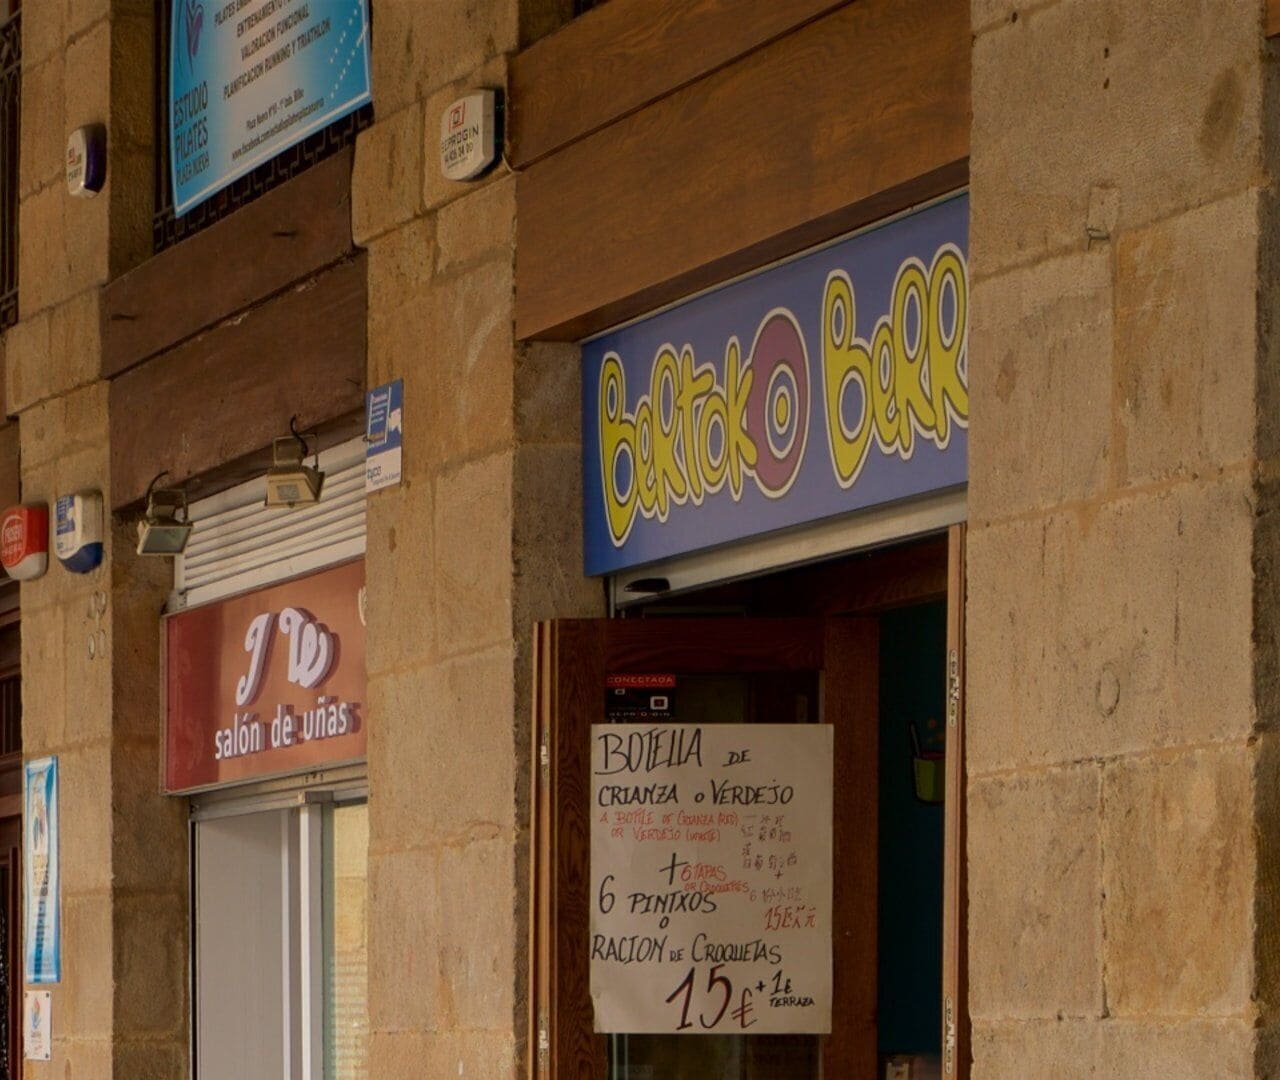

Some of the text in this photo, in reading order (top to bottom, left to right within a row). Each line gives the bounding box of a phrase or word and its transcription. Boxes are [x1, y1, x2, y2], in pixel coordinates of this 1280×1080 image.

[174, 80, 208, 130] ESTUDIO
[821, 241, 969, 489] BeRR
[215, 697, 348, 761] salón de uñas
[594, 727, 752, 775] BOTELLA DE
[598, 783, 679, 808] CRIANZA
[711, 778, 794, 806] VERDEJO
[693, 861, 727, 882] TAPAS
[599, 874, 717, 914] 6 PINTXOS
[591, 933, 782, 965] RACION DE CROQUETAS
[769, 995, 815, 1008] TERRAZA
